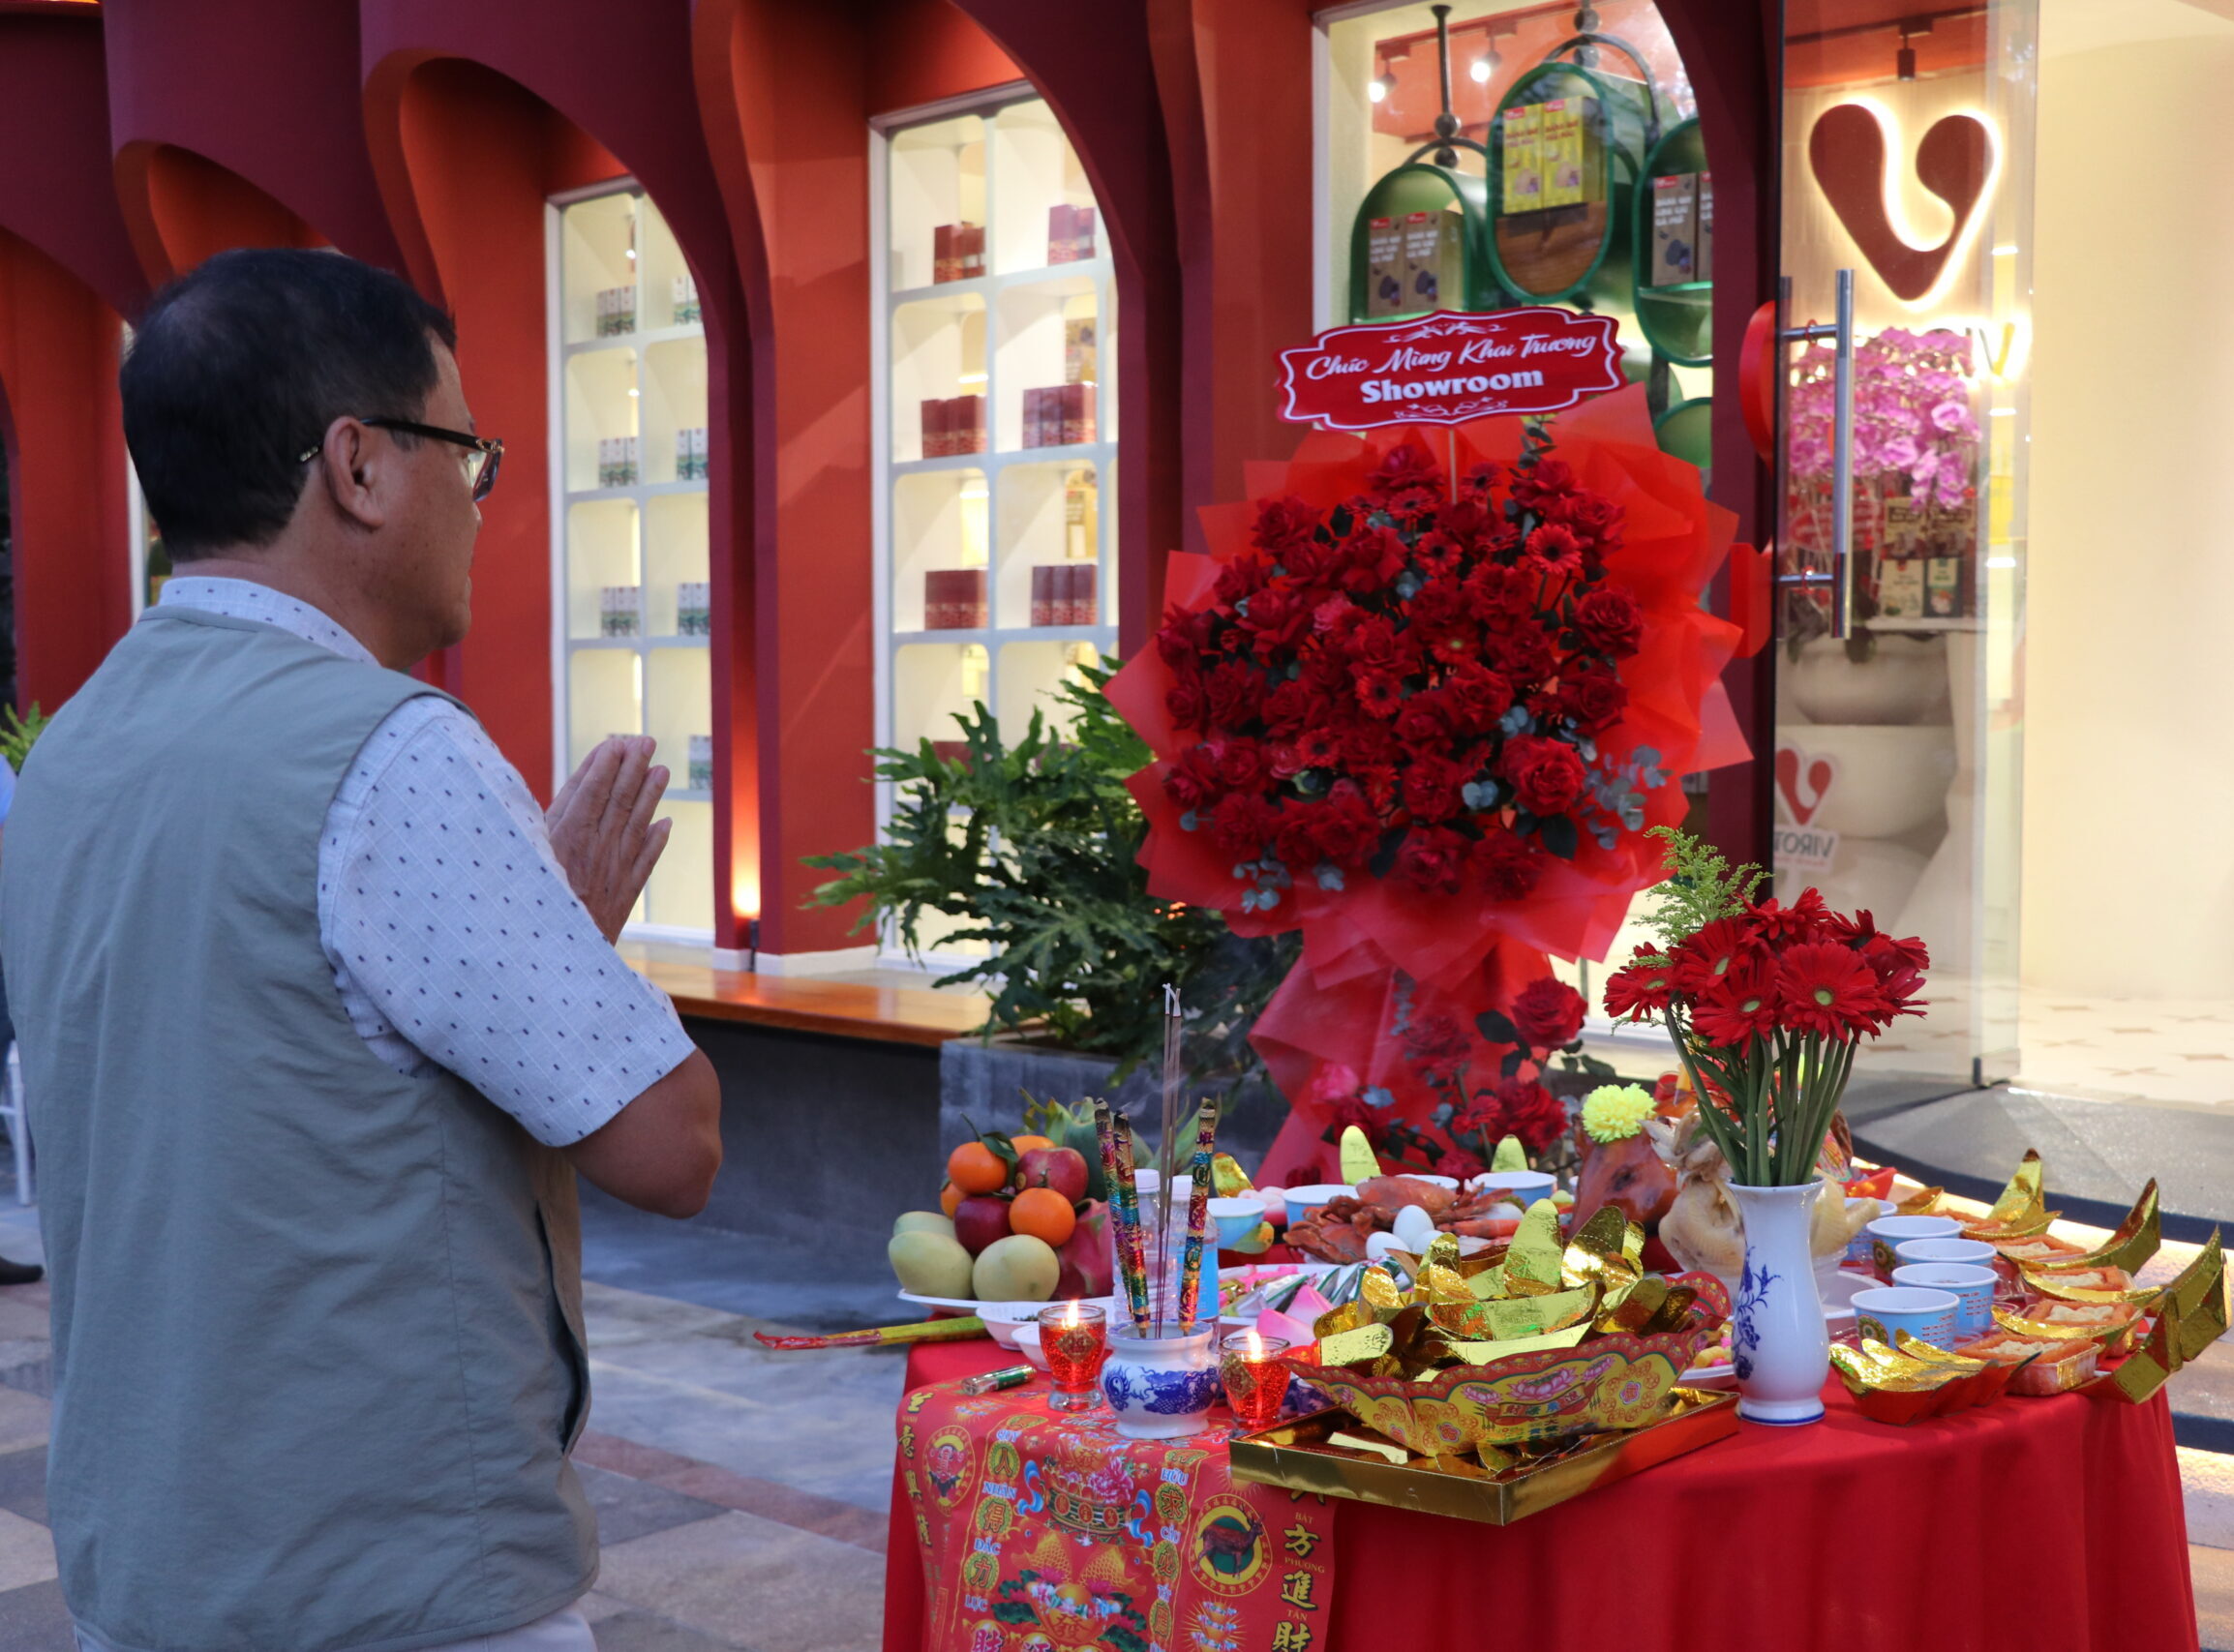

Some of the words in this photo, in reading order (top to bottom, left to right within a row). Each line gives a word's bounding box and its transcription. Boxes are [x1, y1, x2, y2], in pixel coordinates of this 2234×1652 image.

[1306, 355, 1370, 380] Chúc
[1457, 339, 1516, 365] Khai
[1360, 369, 1545, 405] Showroom
[994, 1446, 1013, 1478] 人
[983, 1501, 1008, 1534] 得
[1161, 1487, 1184, 1519] 求
[1282, 1522, 1321, 1559] 方
[970, 1555, 992, 1587] 力
[1280, 1569, 1318, 1609] 進
